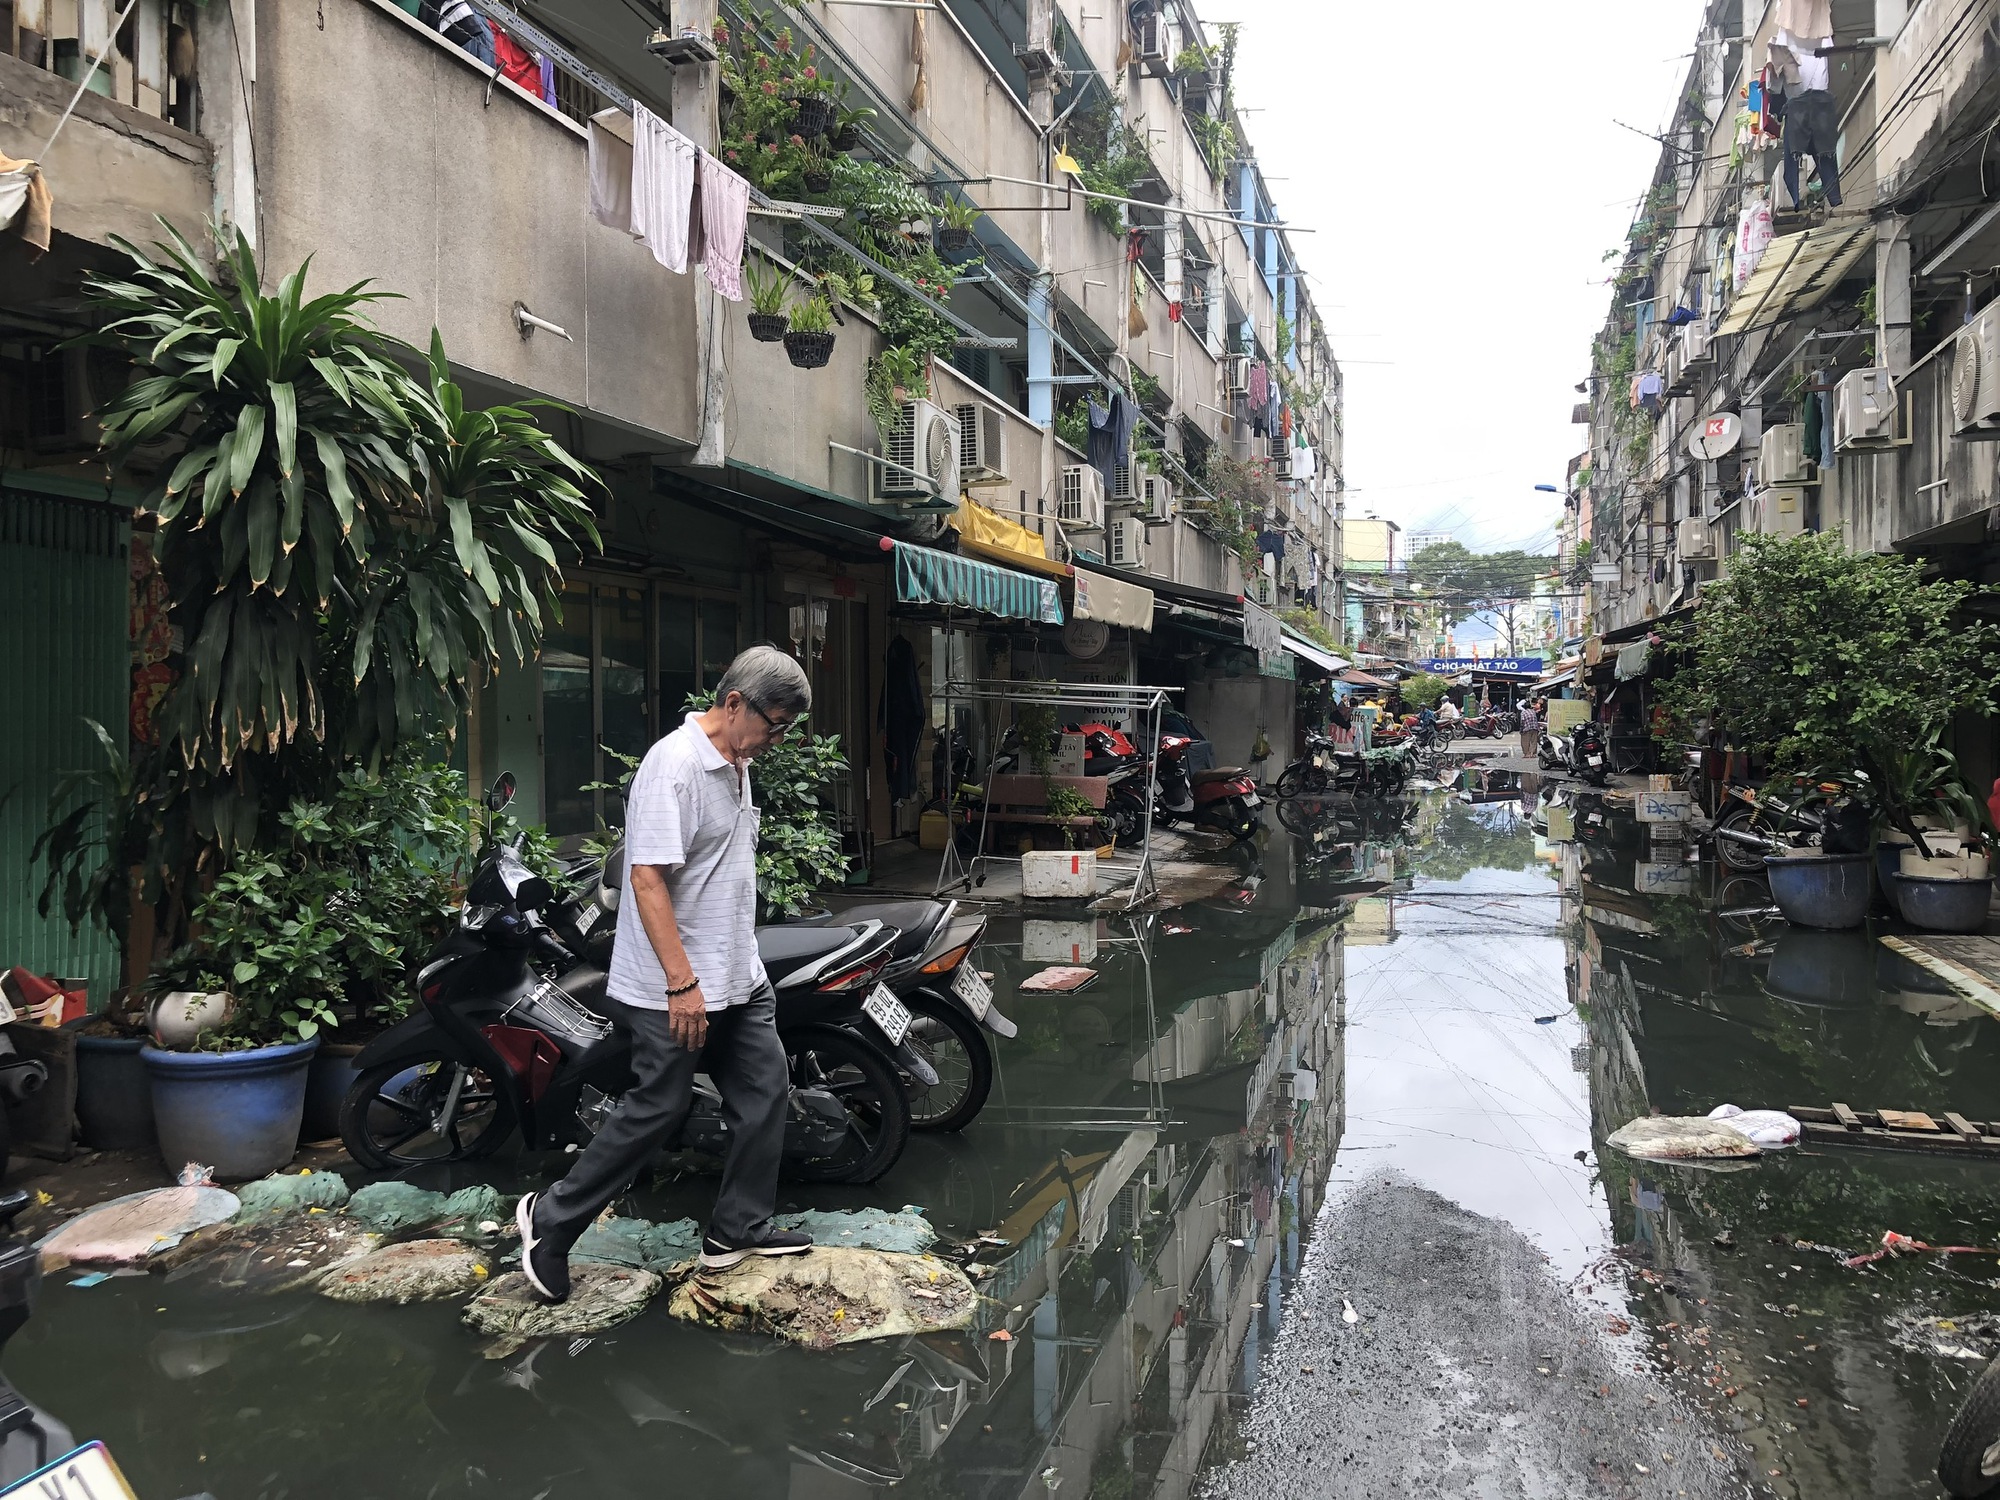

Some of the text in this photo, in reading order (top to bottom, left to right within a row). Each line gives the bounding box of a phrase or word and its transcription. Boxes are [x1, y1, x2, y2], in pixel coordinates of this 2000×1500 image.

[1433, 661, 1458, 672] CHỢ
[1495, 659, 1518, 670] TẢO
[884, 1002, 909, 1042] 299.82
